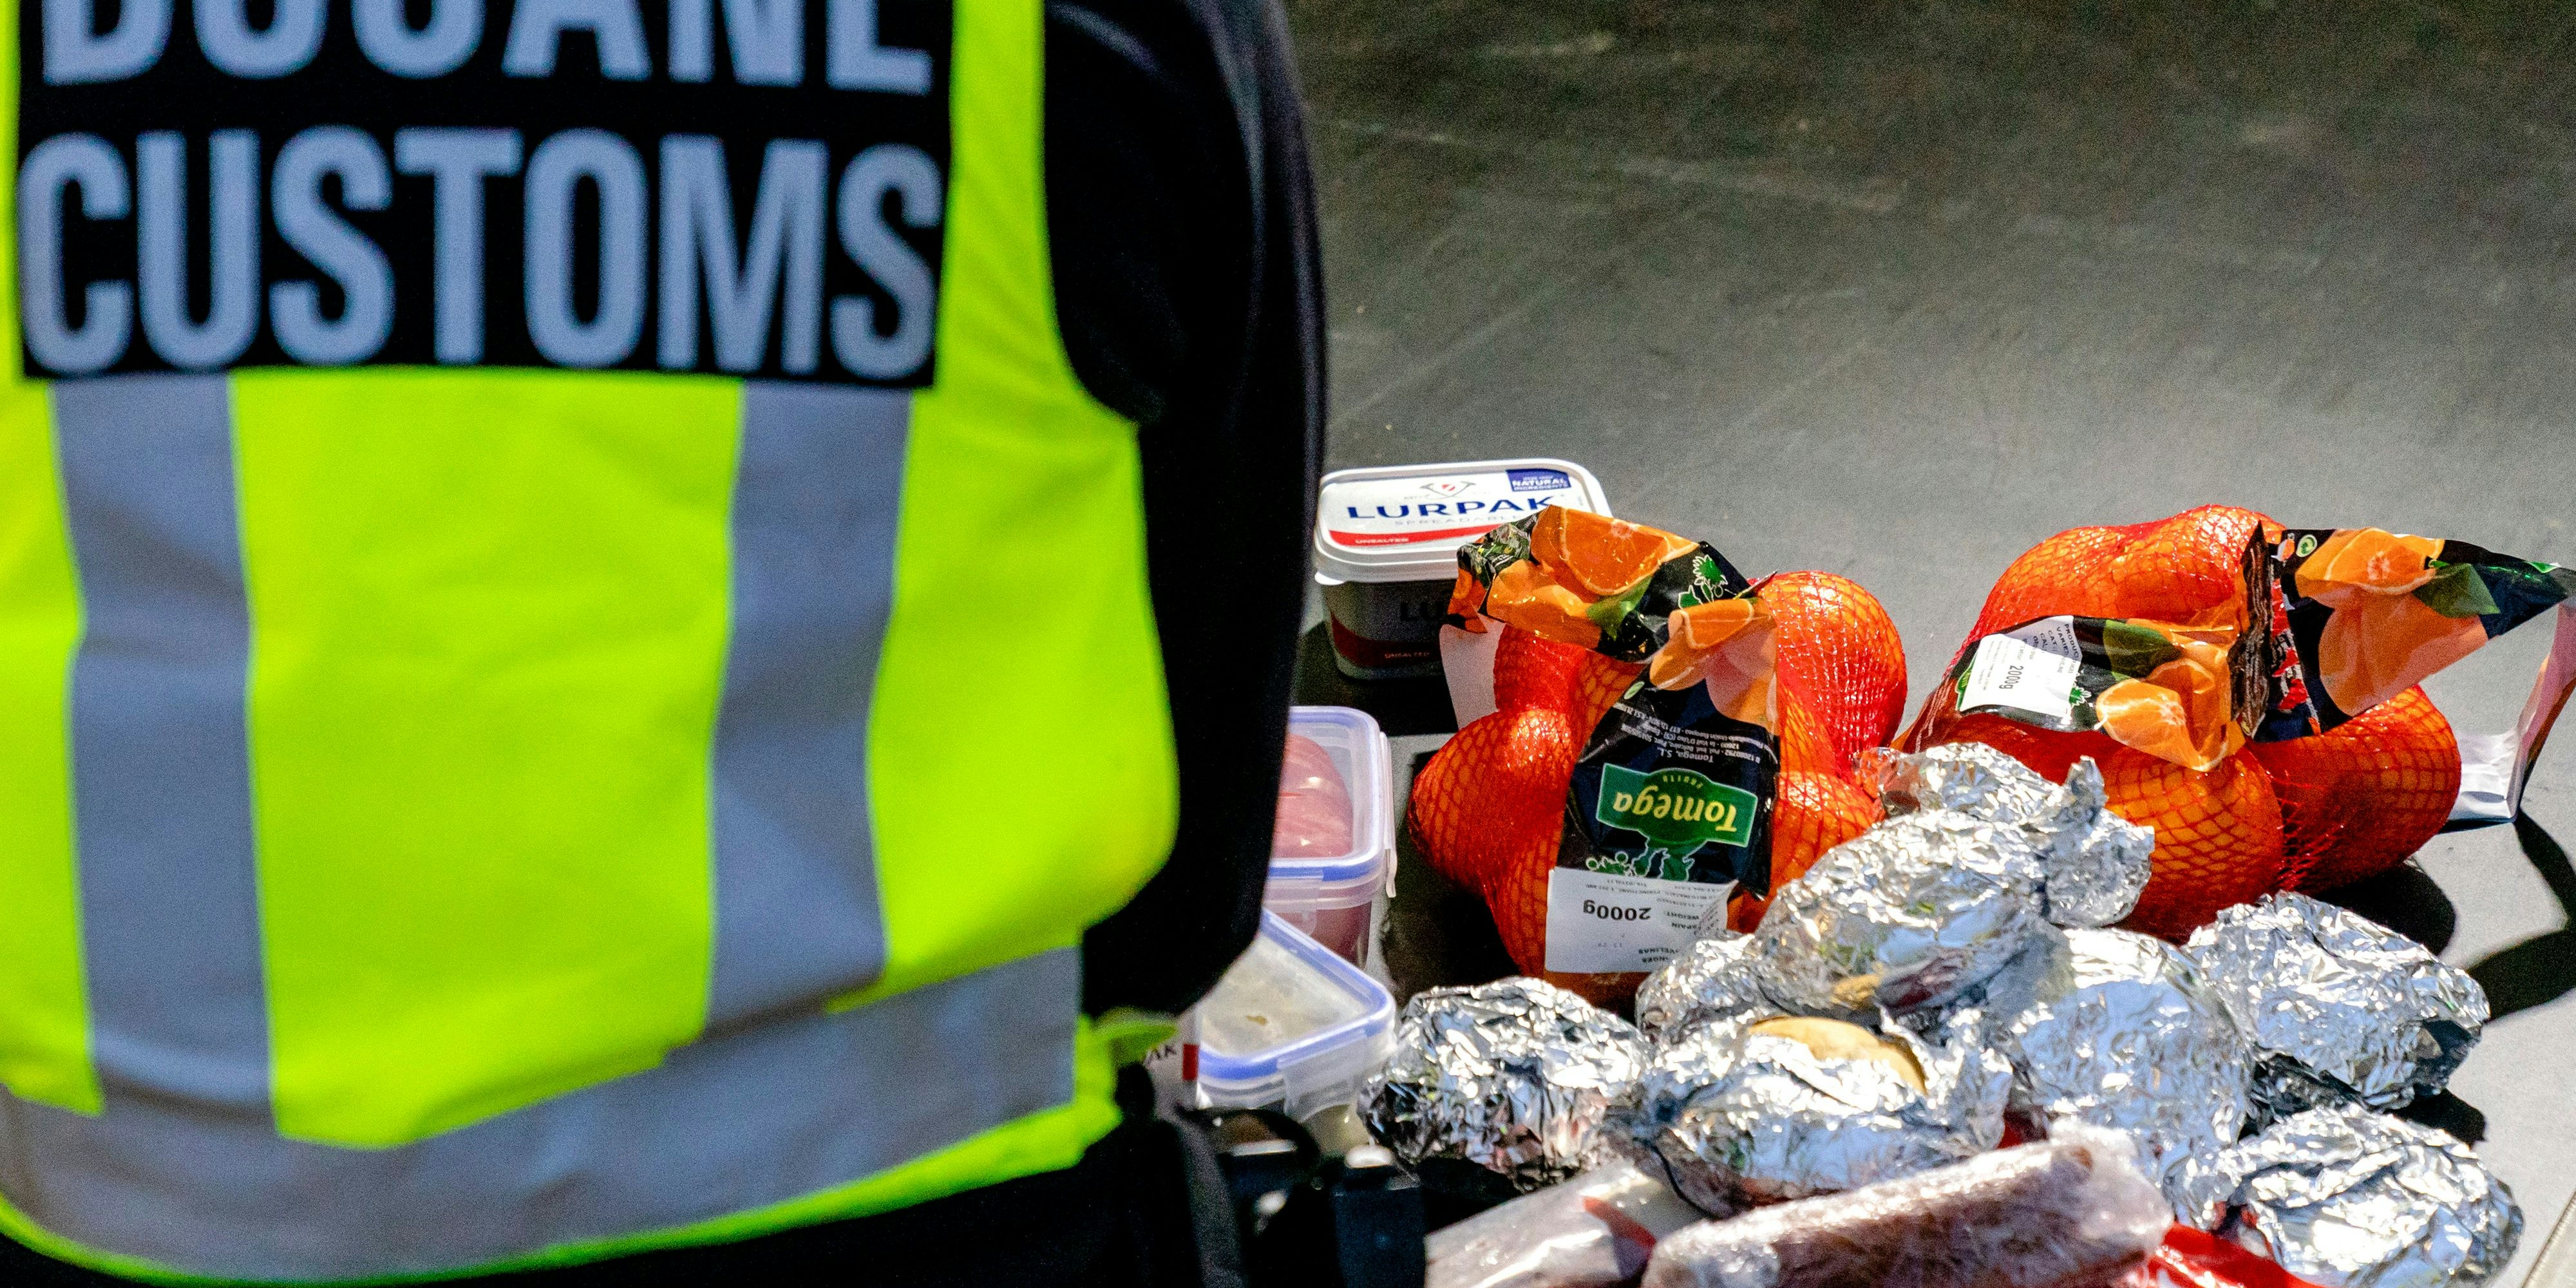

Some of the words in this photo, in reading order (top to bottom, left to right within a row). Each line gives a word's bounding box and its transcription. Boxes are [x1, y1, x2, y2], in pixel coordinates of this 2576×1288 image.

[17, 126, 942, 380] CUSTOMS
[1512, 477, 1566, 486] NATURAL
[1347, 495, 1555, 518] LURPAK
[1999, 665, 2023, 689] 2000g
[1657, 747, 1672, 758] S.L.
[1676, 750, 1714, 763] Tomega,
[1613, 785, 1737, 832] Tomega
[1583, 900, 1651, 921] 2000g
